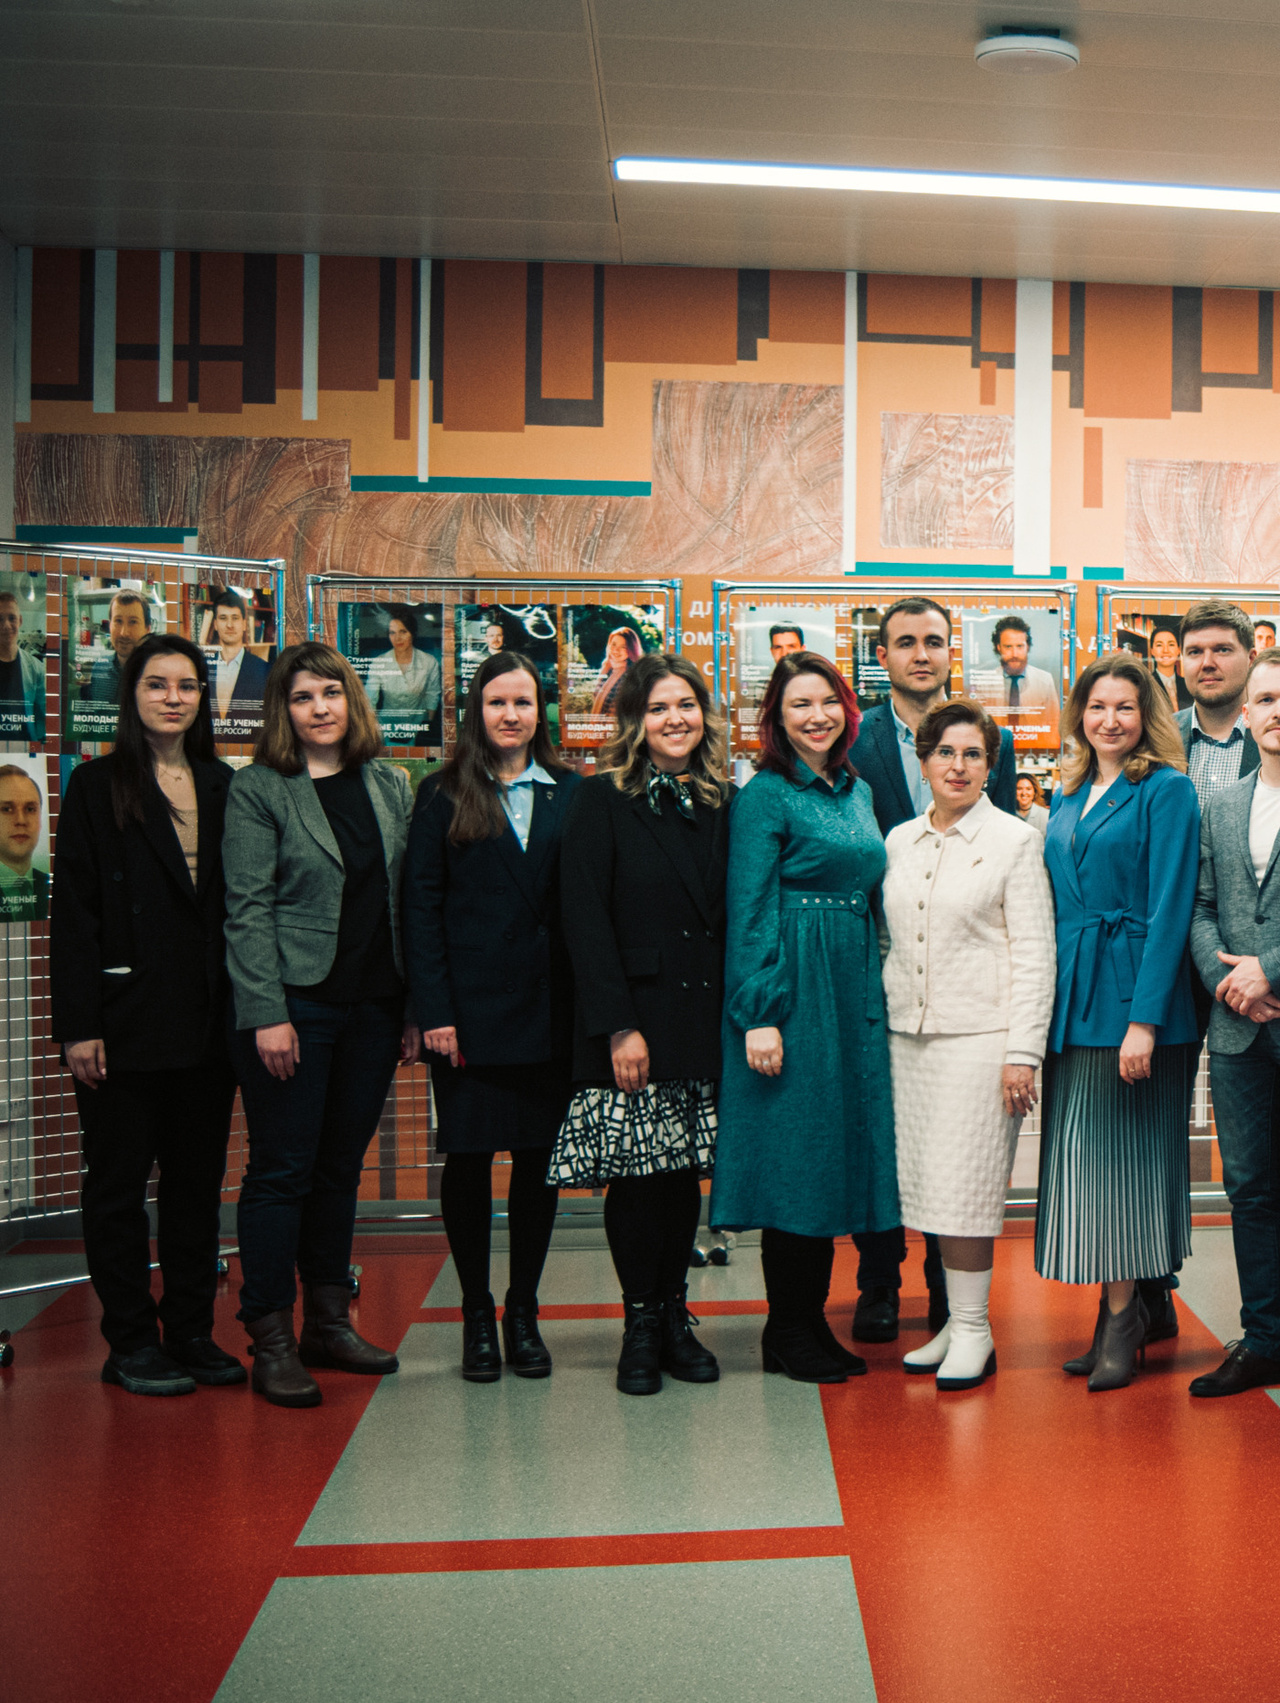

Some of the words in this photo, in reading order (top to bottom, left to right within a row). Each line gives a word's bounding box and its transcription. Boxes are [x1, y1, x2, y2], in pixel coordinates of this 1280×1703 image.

[1, 714, 36, 723] УЧЕНЫЕ
[73, 714, 119, 723] МОЛОДЫЕ
[233, 719, 265, 727] УЧЕНЫЕ
[0, 724, 22, 732] ССИИ
[72, 724, 110, 733] БУДУЩЕЕ
[224, 727, 252, 735] РОССИИ
[394, 723, 430, 731] УЧЕНЫЕ
[567, 723, 613, 732] МОЛОДЫЕ
[2, 895, 38, 904] УЧЕНЫЕ
